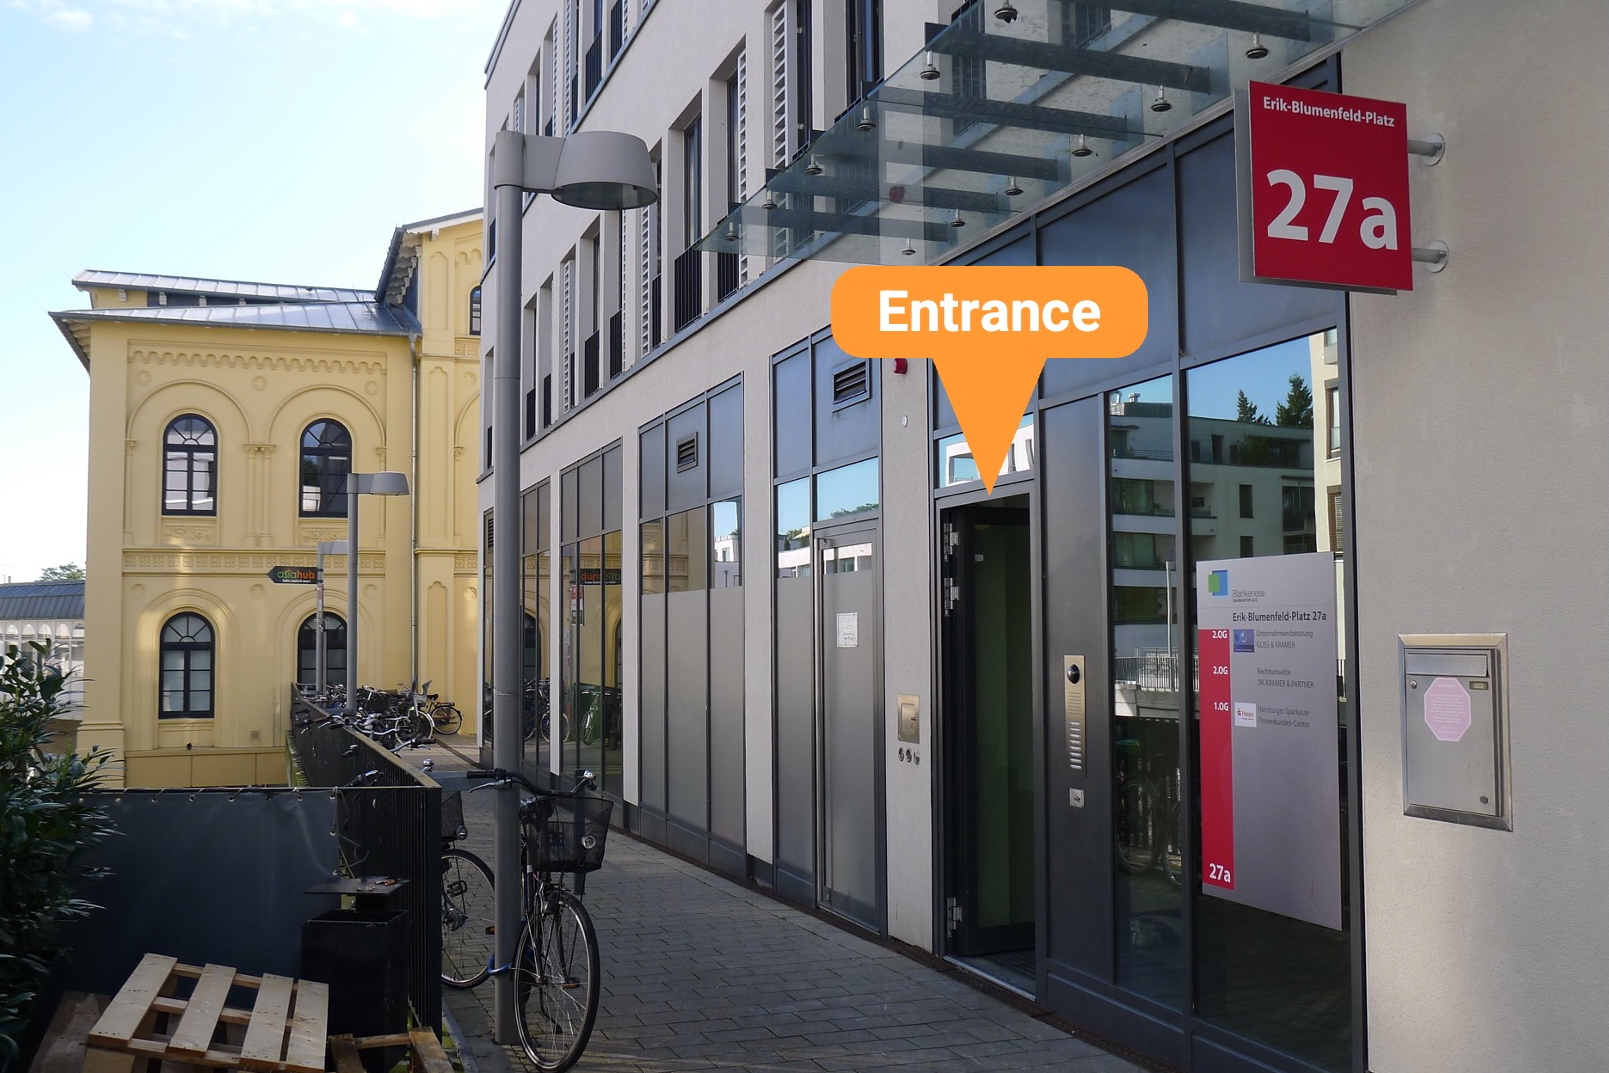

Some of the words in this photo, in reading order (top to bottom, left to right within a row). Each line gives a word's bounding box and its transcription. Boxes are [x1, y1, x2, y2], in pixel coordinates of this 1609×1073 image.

[1263, 96, 1395, 127] Erik-Blumenfeld-Platz
[1266, 168, 1398, 250] 27a
[1232, 589, 1265, 598] Blankenese
[1232, 611, 1311, 622] Erik-Blumenfeld-Platz
[1312, 611, 1327, 621] 27a
[1256, 630, 1314, 639] Unternehmensberatung
[1257, 667, 1291, 676] Rechtsanwälte
[1286, 680, 1291, 688] &
[1291, 680, 1314, 689] PARTNER
[1258, 705, 1284, 716] Hamburger
[1285, 707, 1310, 717] Sparkasse
[1258, 717, 1310, 728] Firmenkunden-Center
[1209, 862, 1231, 883] 27a
